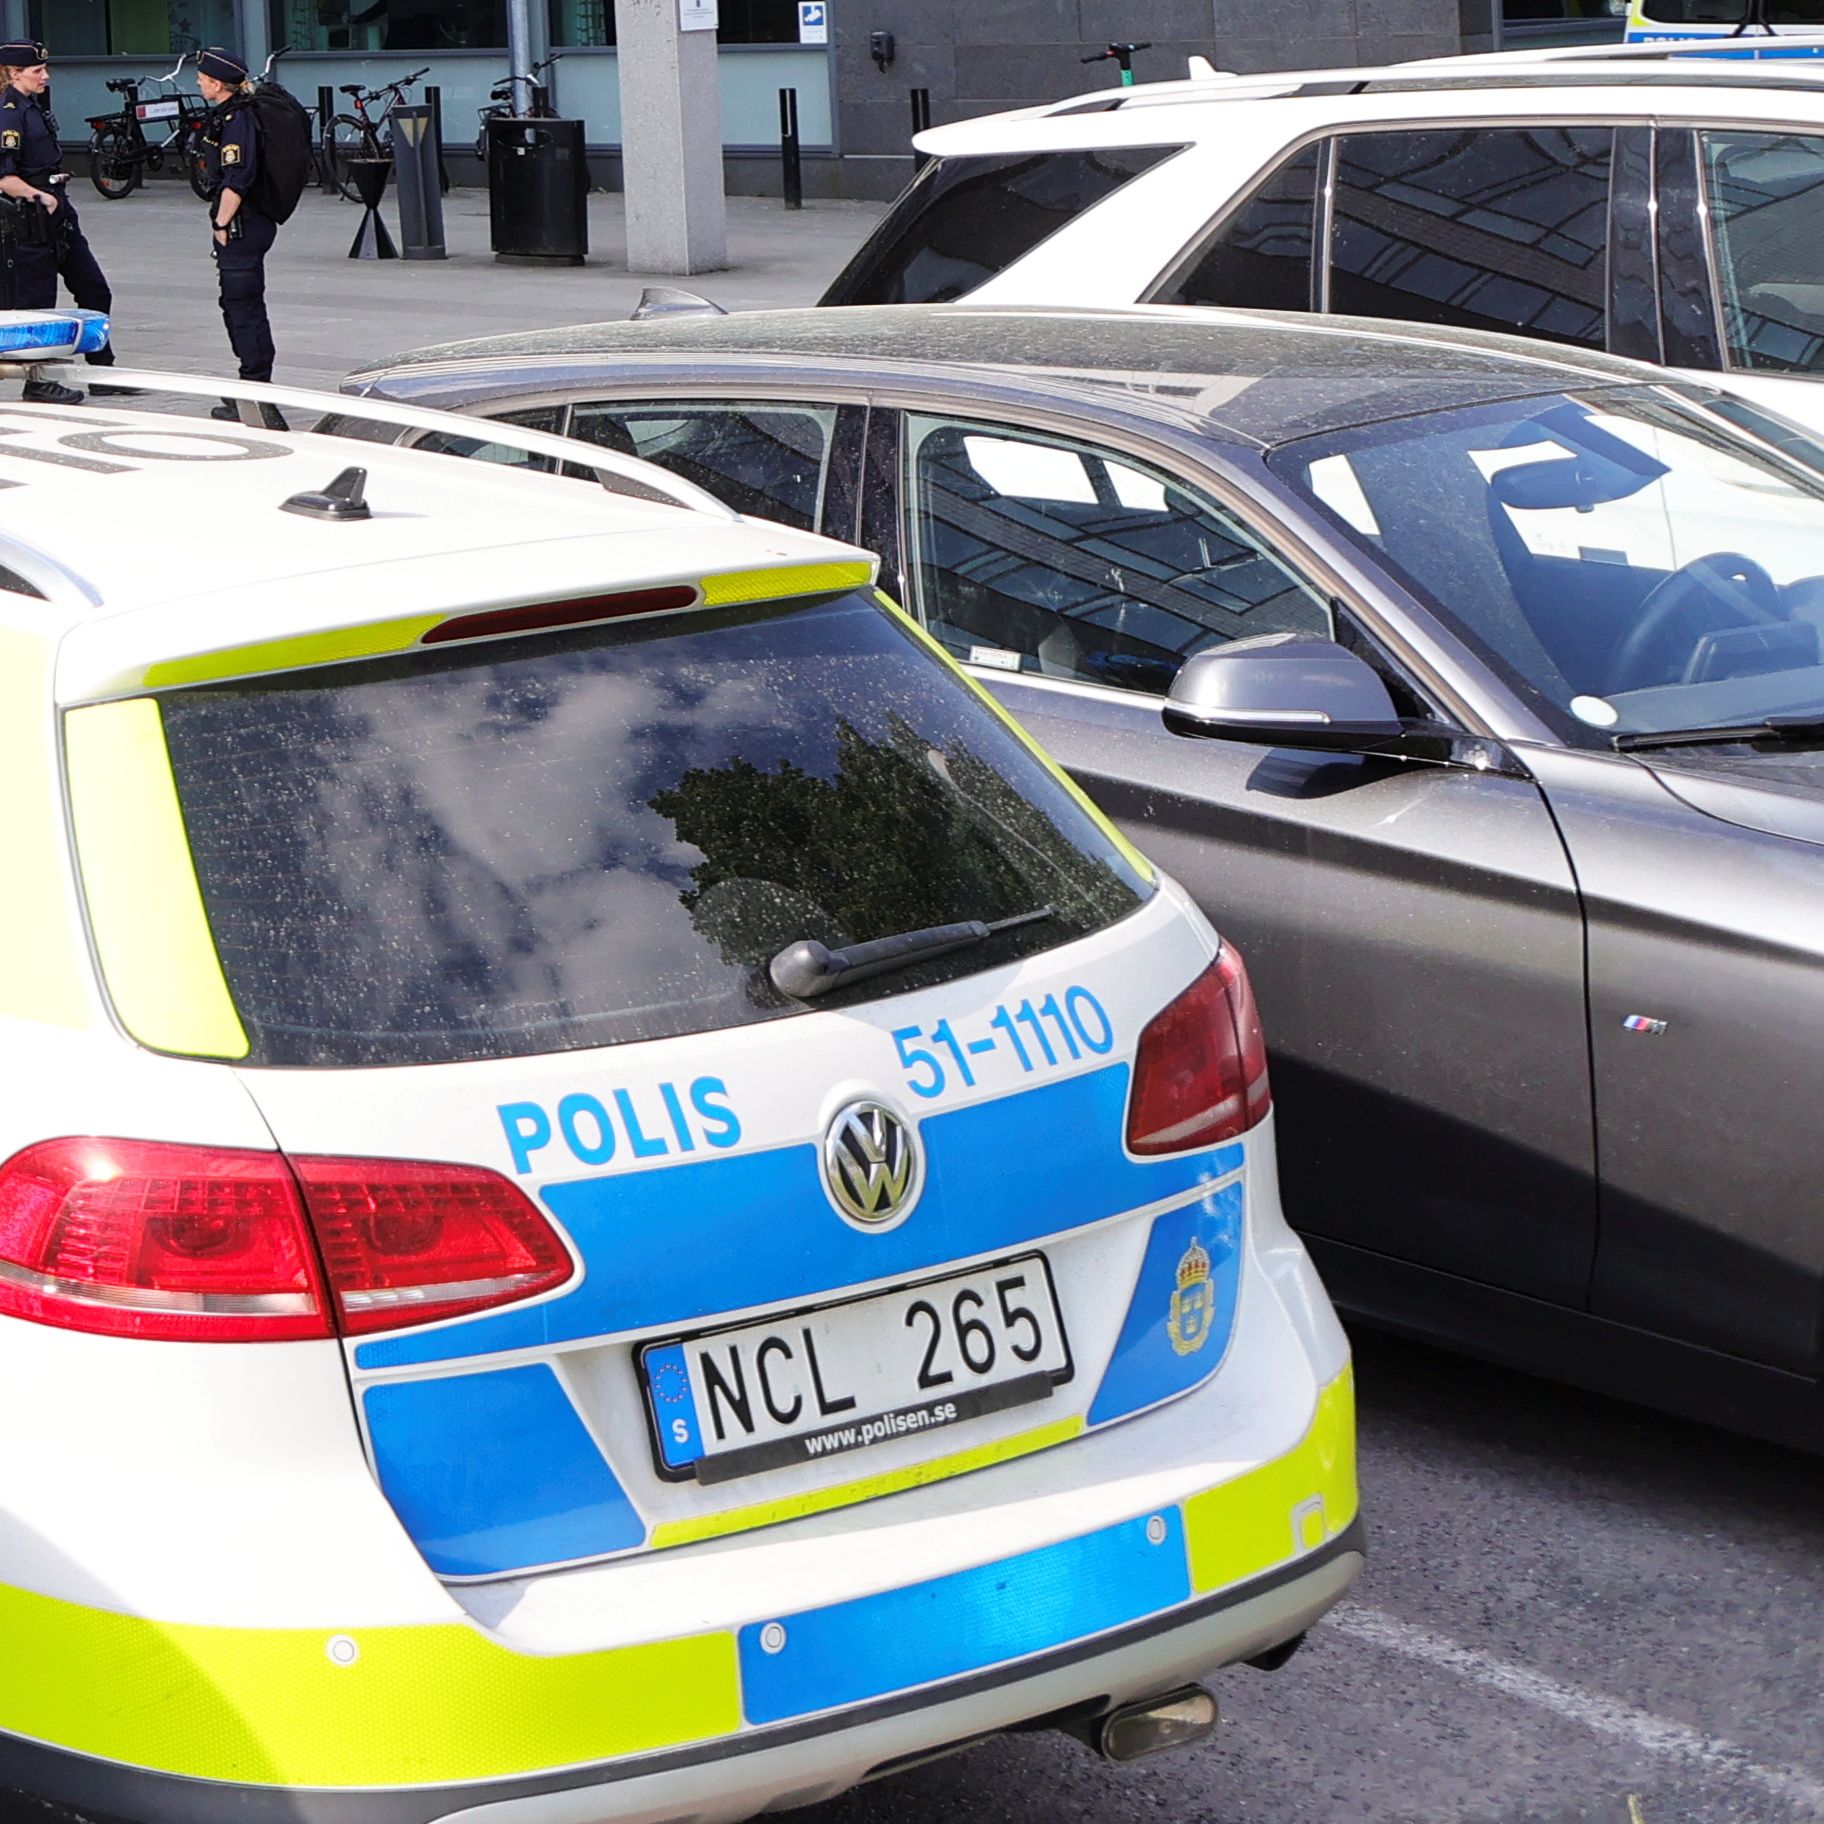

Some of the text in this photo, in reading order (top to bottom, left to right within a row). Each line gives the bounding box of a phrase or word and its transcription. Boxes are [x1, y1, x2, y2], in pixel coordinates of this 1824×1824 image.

[891, 984, 1114, 1099] 51-1110
[496, 1075, 742, 1174] POLIS
[672, 1275, 1042, 1445] S NCL 265
[805, 1400, 958, 1456] www.polisen.se
